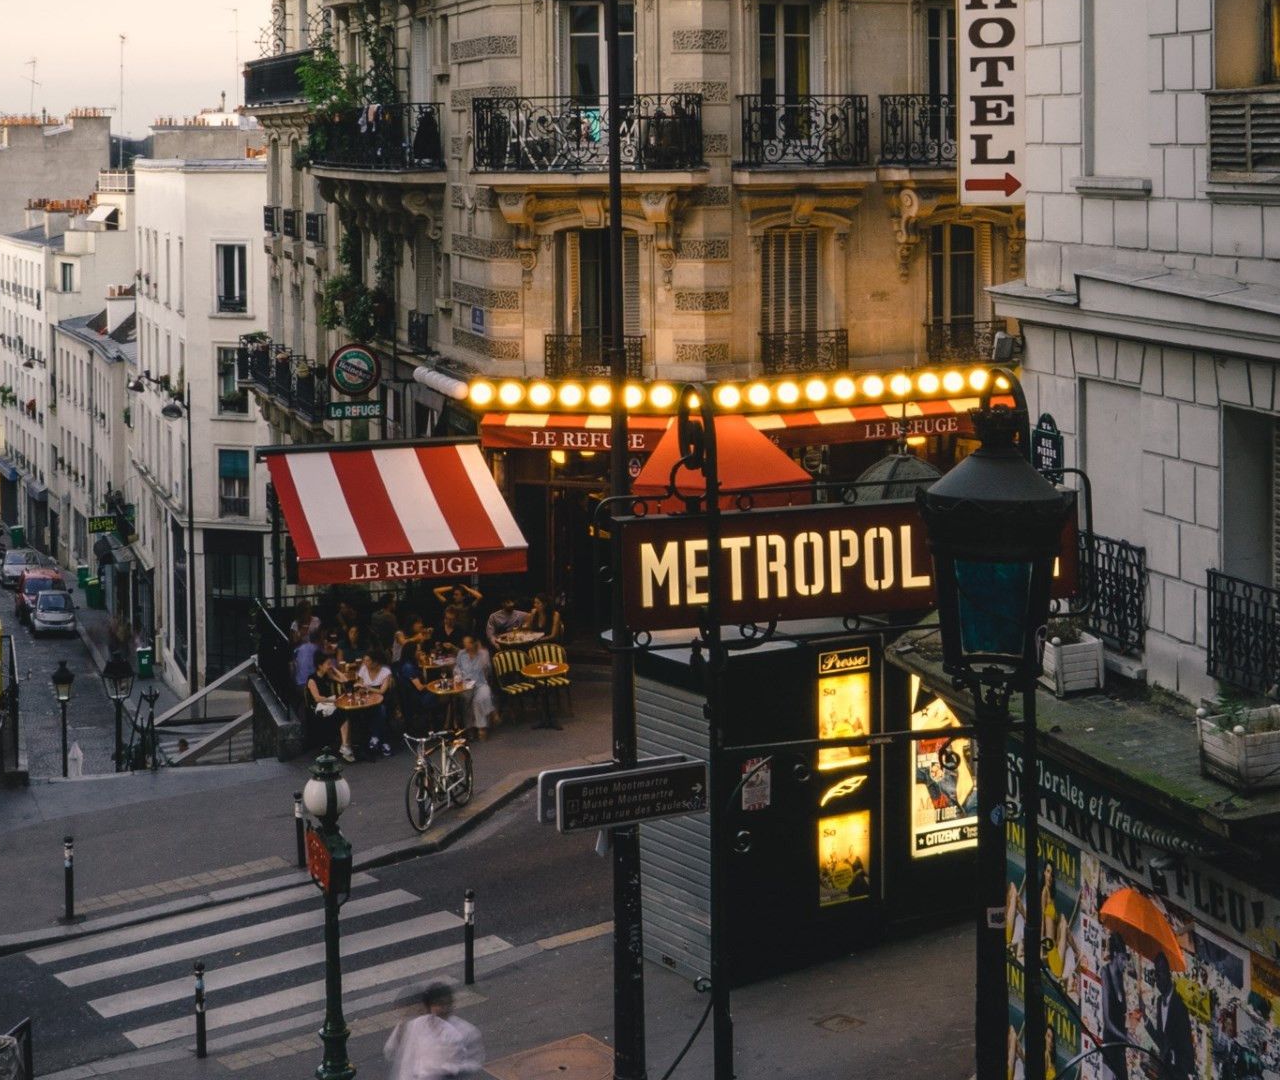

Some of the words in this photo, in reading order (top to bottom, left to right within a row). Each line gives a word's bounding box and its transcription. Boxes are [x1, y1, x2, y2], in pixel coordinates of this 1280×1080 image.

[331, 406, 342, 418] Le
[345, 404, 381, 417] REFUGE
[865, 423, 888, 439] LE
[891, 417, 958, 437] REFUGE
[531, 431, 557, 447] LE
[563, 431, 645, 449] REFUE
[1041, 437, 1053, 449] RUE
[349, 562, 380, 580] LE
[386, 556, 479, 577] REFUGE
[641, 525, 931, 608] METROPOL
[823, 654, 867, 670] Presse
[582, 785, 609, 798] Butte
[612, 776, 669, 793] Montmartre
[617, 788, 674, 804] Montmartre
[1036, 760, 1084, 809] lorales
[1089, 796, 1103, 820] et
[582, 812, 599, 823] Par
[603, 810, 612, 821] la
[614, 808, 631, 818] rue
[635, 805, 651, 816] des
